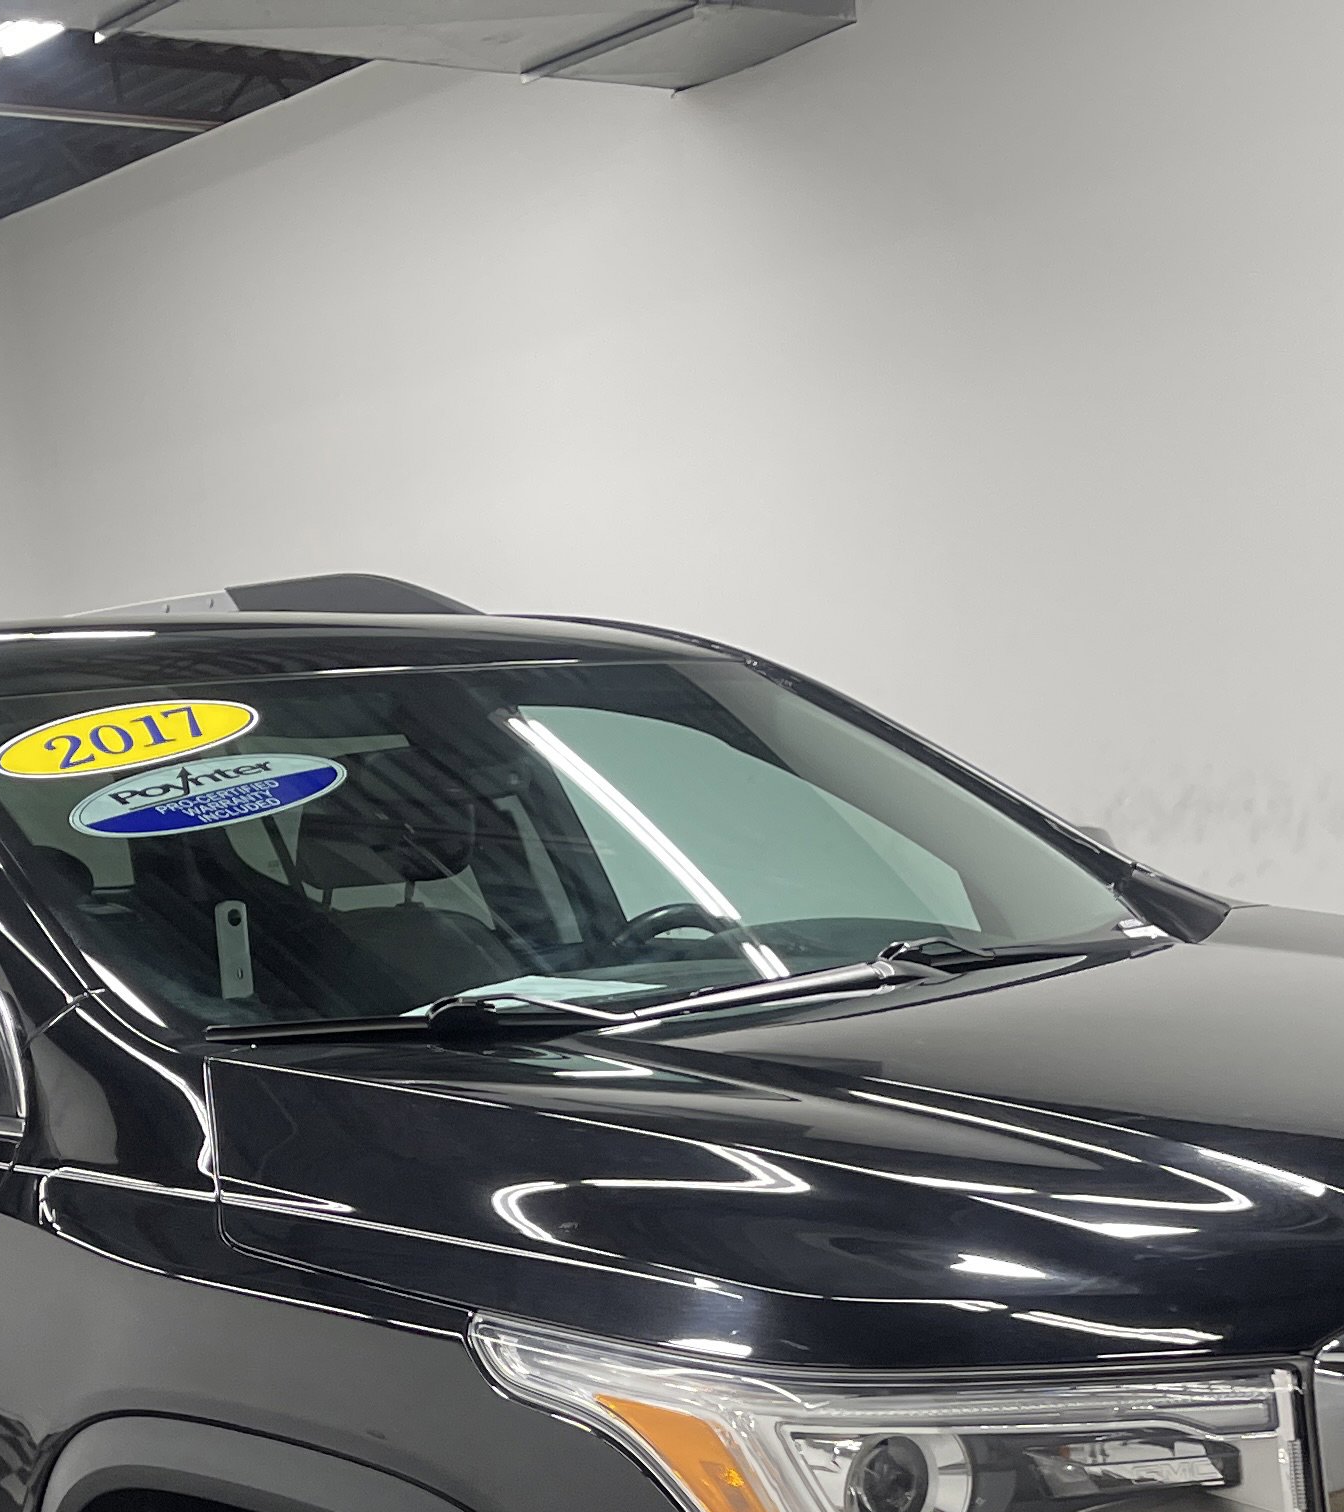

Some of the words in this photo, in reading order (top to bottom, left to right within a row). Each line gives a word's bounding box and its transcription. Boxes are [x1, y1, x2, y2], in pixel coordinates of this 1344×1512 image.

[45, 706, 203, 769] 2017
[109, 761, 272, 806] Poynter
[155, 780, 279, 815] PRO-CERTIFIED
[182, 790, 273, 817] WARRANTY
[198, 798, 281, 823] INCLUDED
